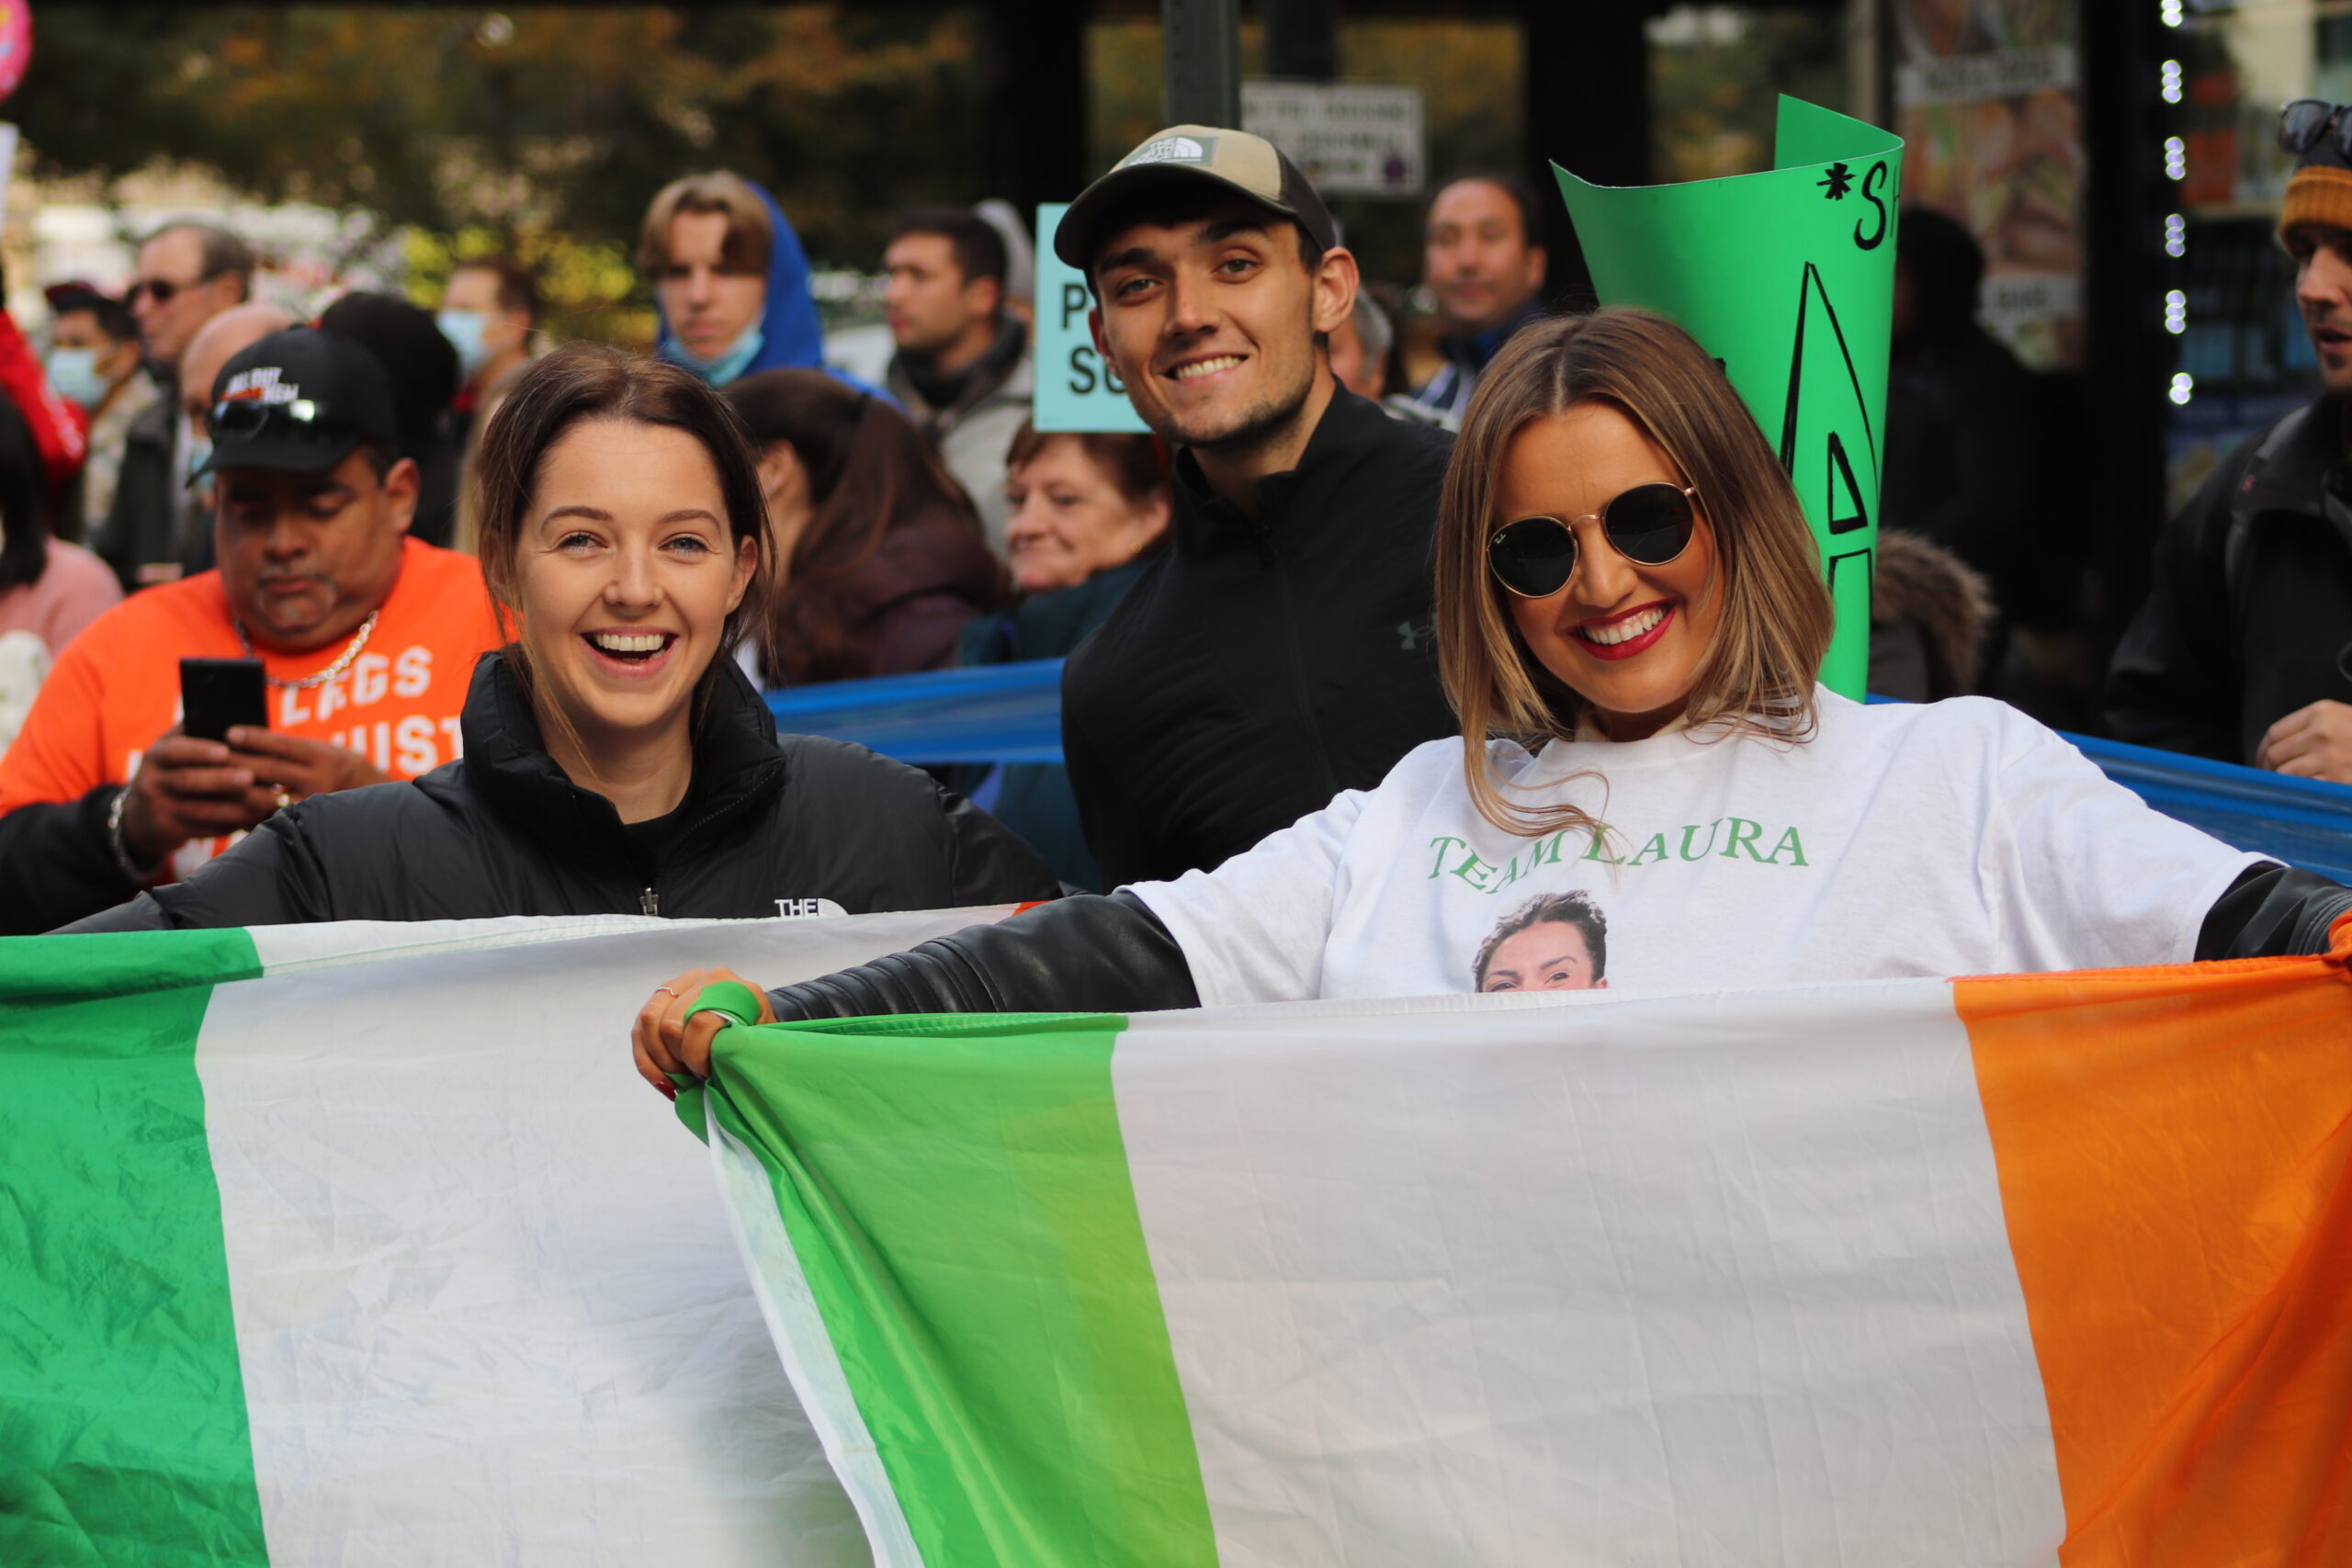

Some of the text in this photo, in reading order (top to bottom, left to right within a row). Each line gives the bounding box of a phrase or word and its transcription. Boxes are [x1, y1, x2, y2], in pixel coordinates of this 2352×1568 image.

[1061, 283, 1088, 331] P
[1427, 816, 1809, 895] TEAM LAURA
[775, 897, 818, 917] THE
